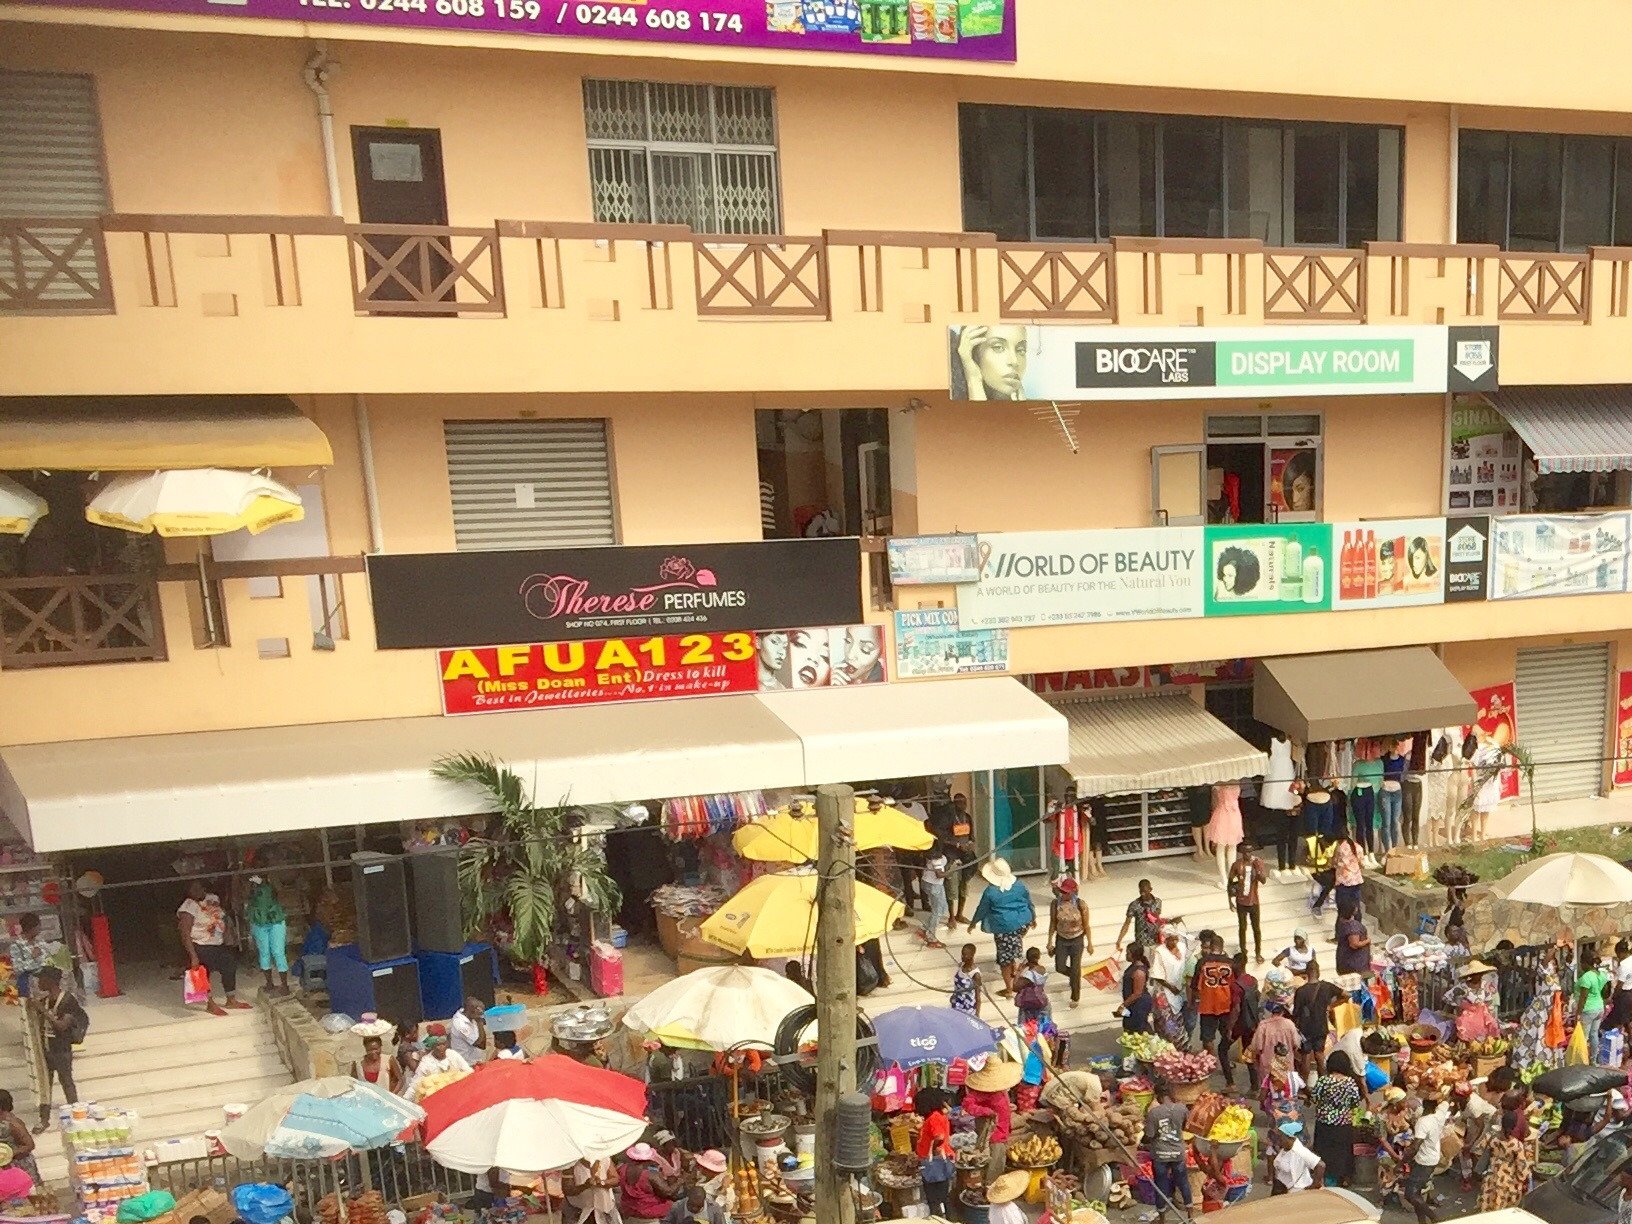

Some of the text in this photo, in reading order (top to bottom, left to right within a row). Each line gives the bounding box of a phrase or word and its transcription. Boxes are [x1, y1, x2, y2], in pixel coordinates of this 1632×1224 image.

[435, 0, 485, 17] 608
[494, 0, 541, 20] 159
[576, 5, 639, 27] 0244
[645, 9, 692, 31] 608
[700, 12, 744, 33] 174
[1095, 347, 1188, 374] BIOCARE
[1231, 349, 1400, 377] DISPLAY ROOM
[1161, 371, 1189, 383] LABS
[1079, 552, 1110, 575] OF
[1115, 549, 1195, 573] BEAUTY
[524, 574, 658, 619] Therese
[976, 573, 1192, 597] A WORLD OF BEAUTY FOR THE Natural You
[664, 590, 746, 610] PERFUMES
[901, 612, 923, 628] PICK
[923, 611, 942, 626] MIX
[478, 665, 727, 693] (Miss Doan Ent) Dress to kill
[471, 693, 506, 706] Best
[508, 694, 522, 703] in
[658, 683, 672, 692] in
[674, 679, 731, 691] make-up
[1204, 964, 1232, 988] 52
